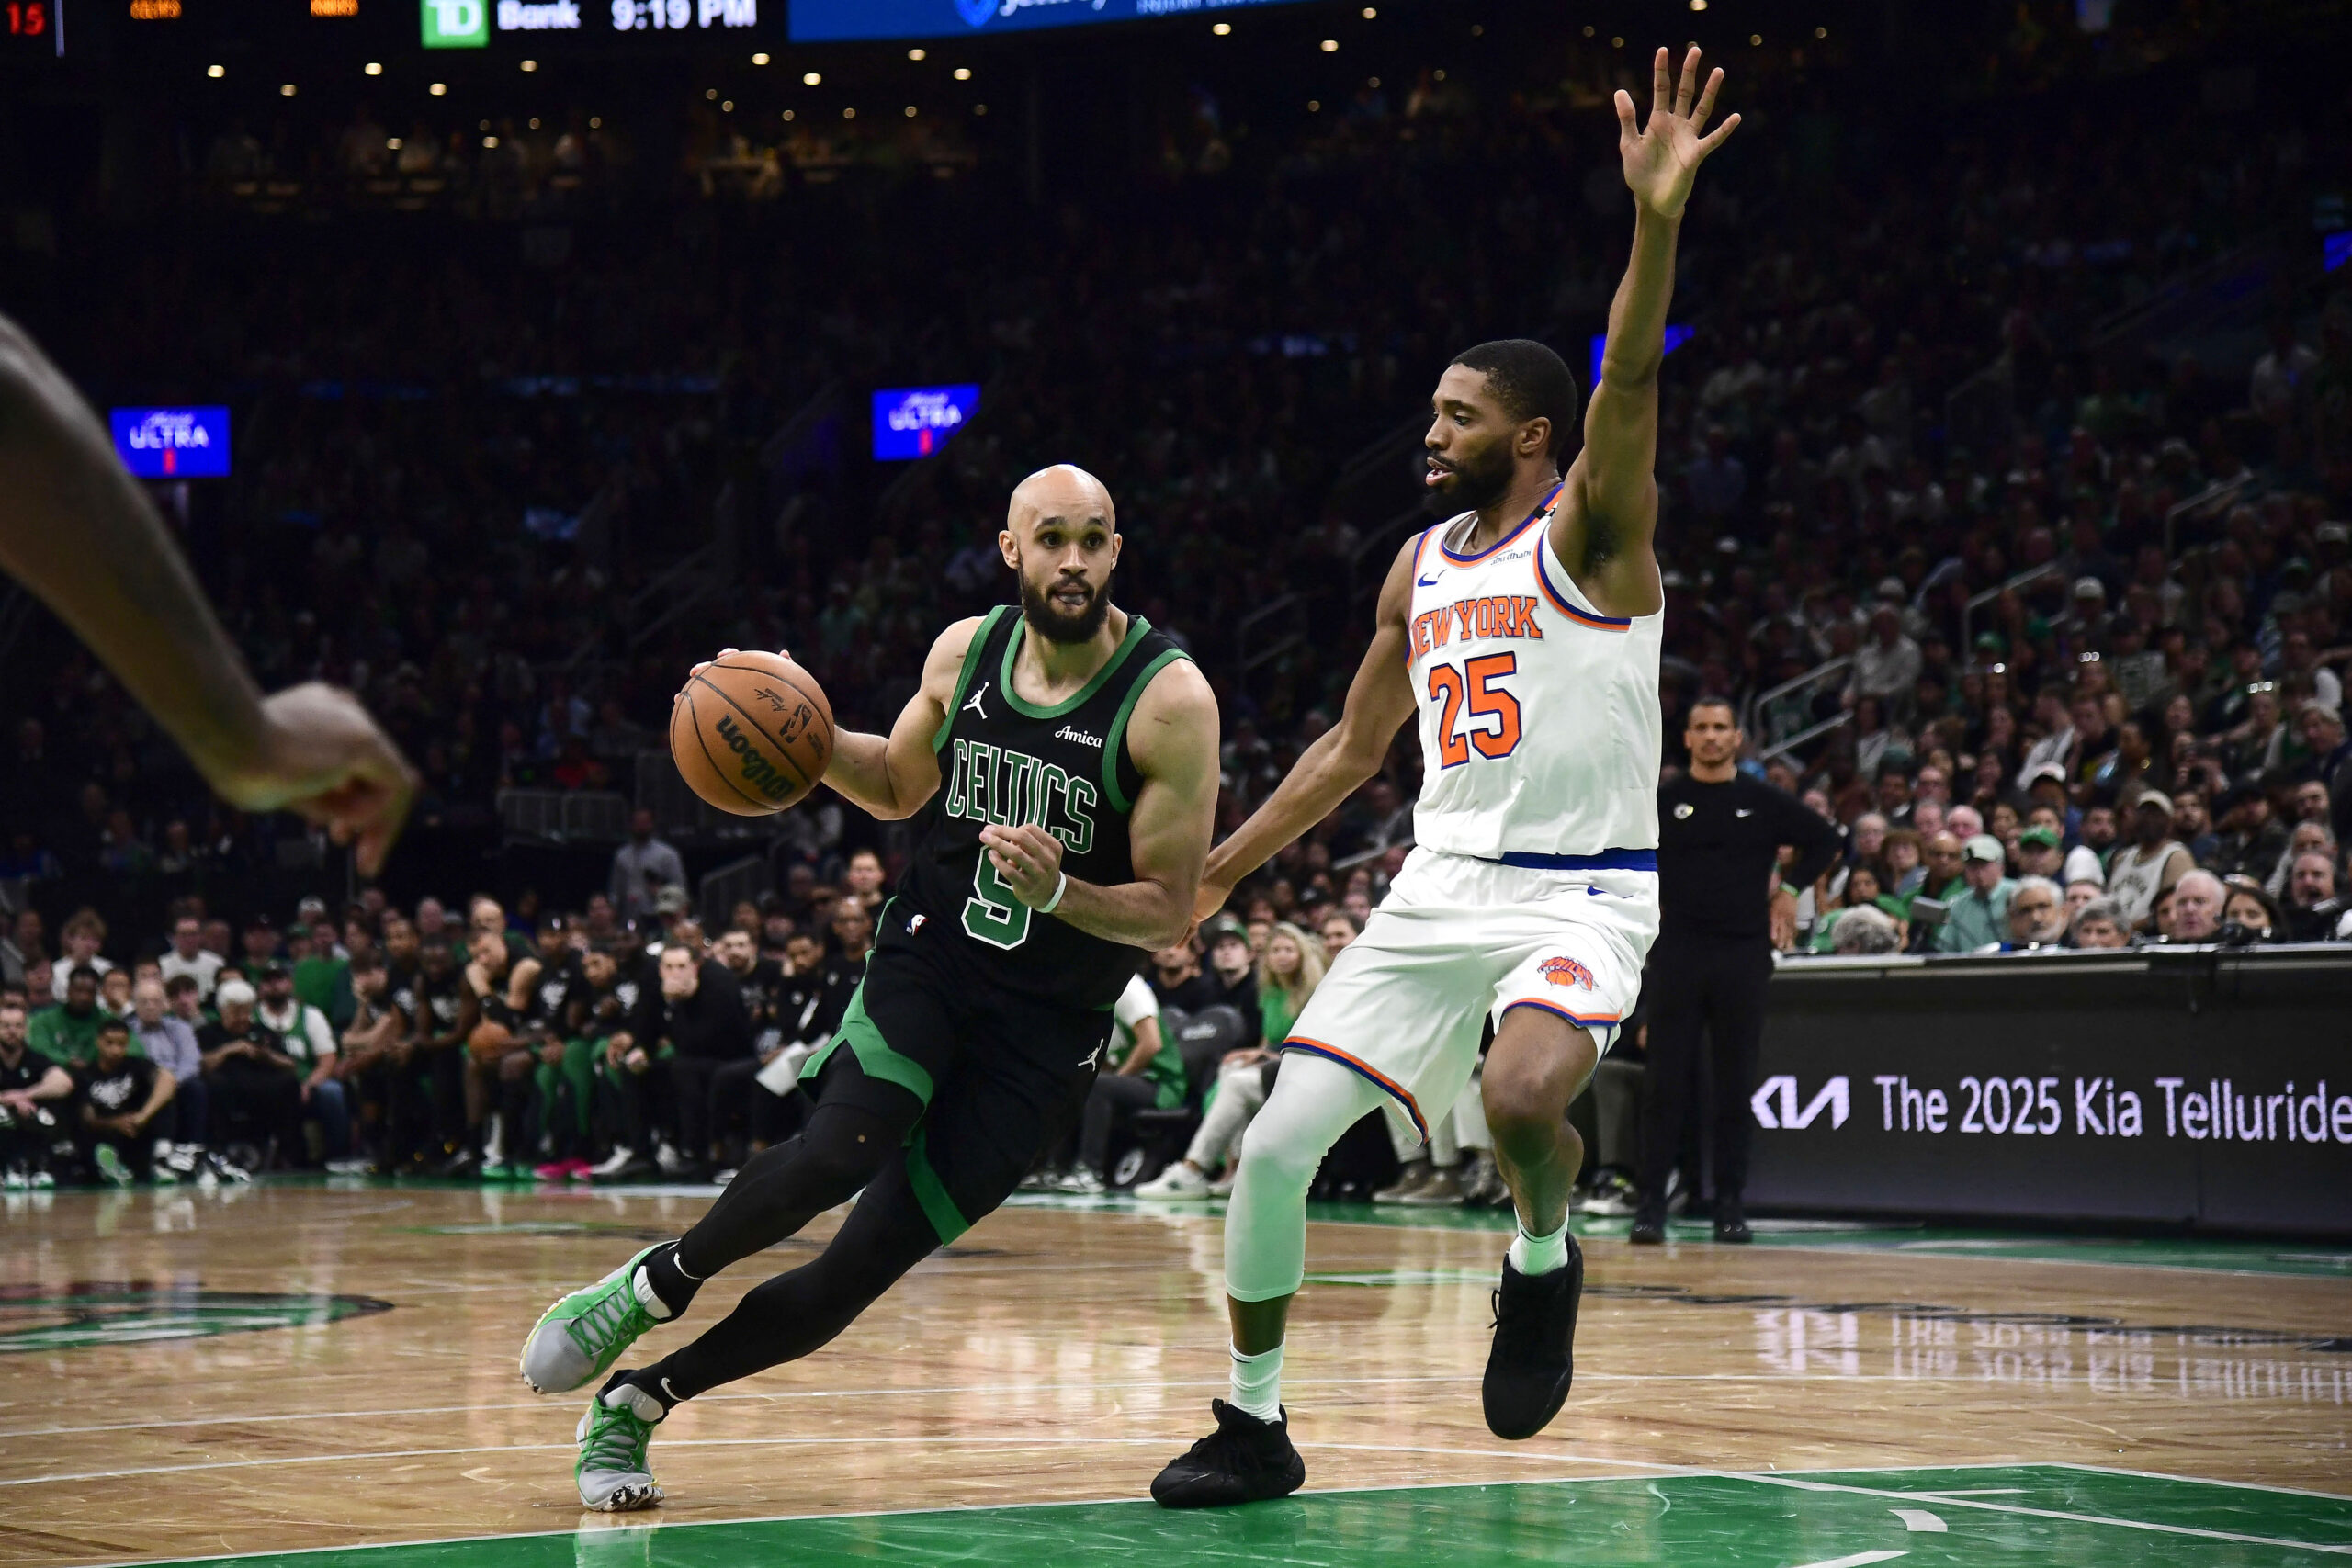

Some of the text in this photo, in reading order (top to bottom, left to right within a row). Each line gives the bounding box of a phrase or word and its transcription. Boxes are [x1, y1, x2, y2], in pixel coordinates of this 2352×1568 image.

[425, 0, 581, 35] TD Bank
[611, 0, 757, 31] 9:19 PM
[130, 425, 209, 449] ULTRA
[1454, 595, 1544, 641] YORK
[1428, 650, 1522, 770] 25
[1055, 725, 1102, 749] Amica
[945, 738, 1098, 854] CELTICS
[1873, 1075, 1949, 1133] The
[1959, 1076, 2062, 1135] 2025
[2075, 1077, 2143, 1137] Kia
[2154, 1077, 2352, 1143] Telluride
